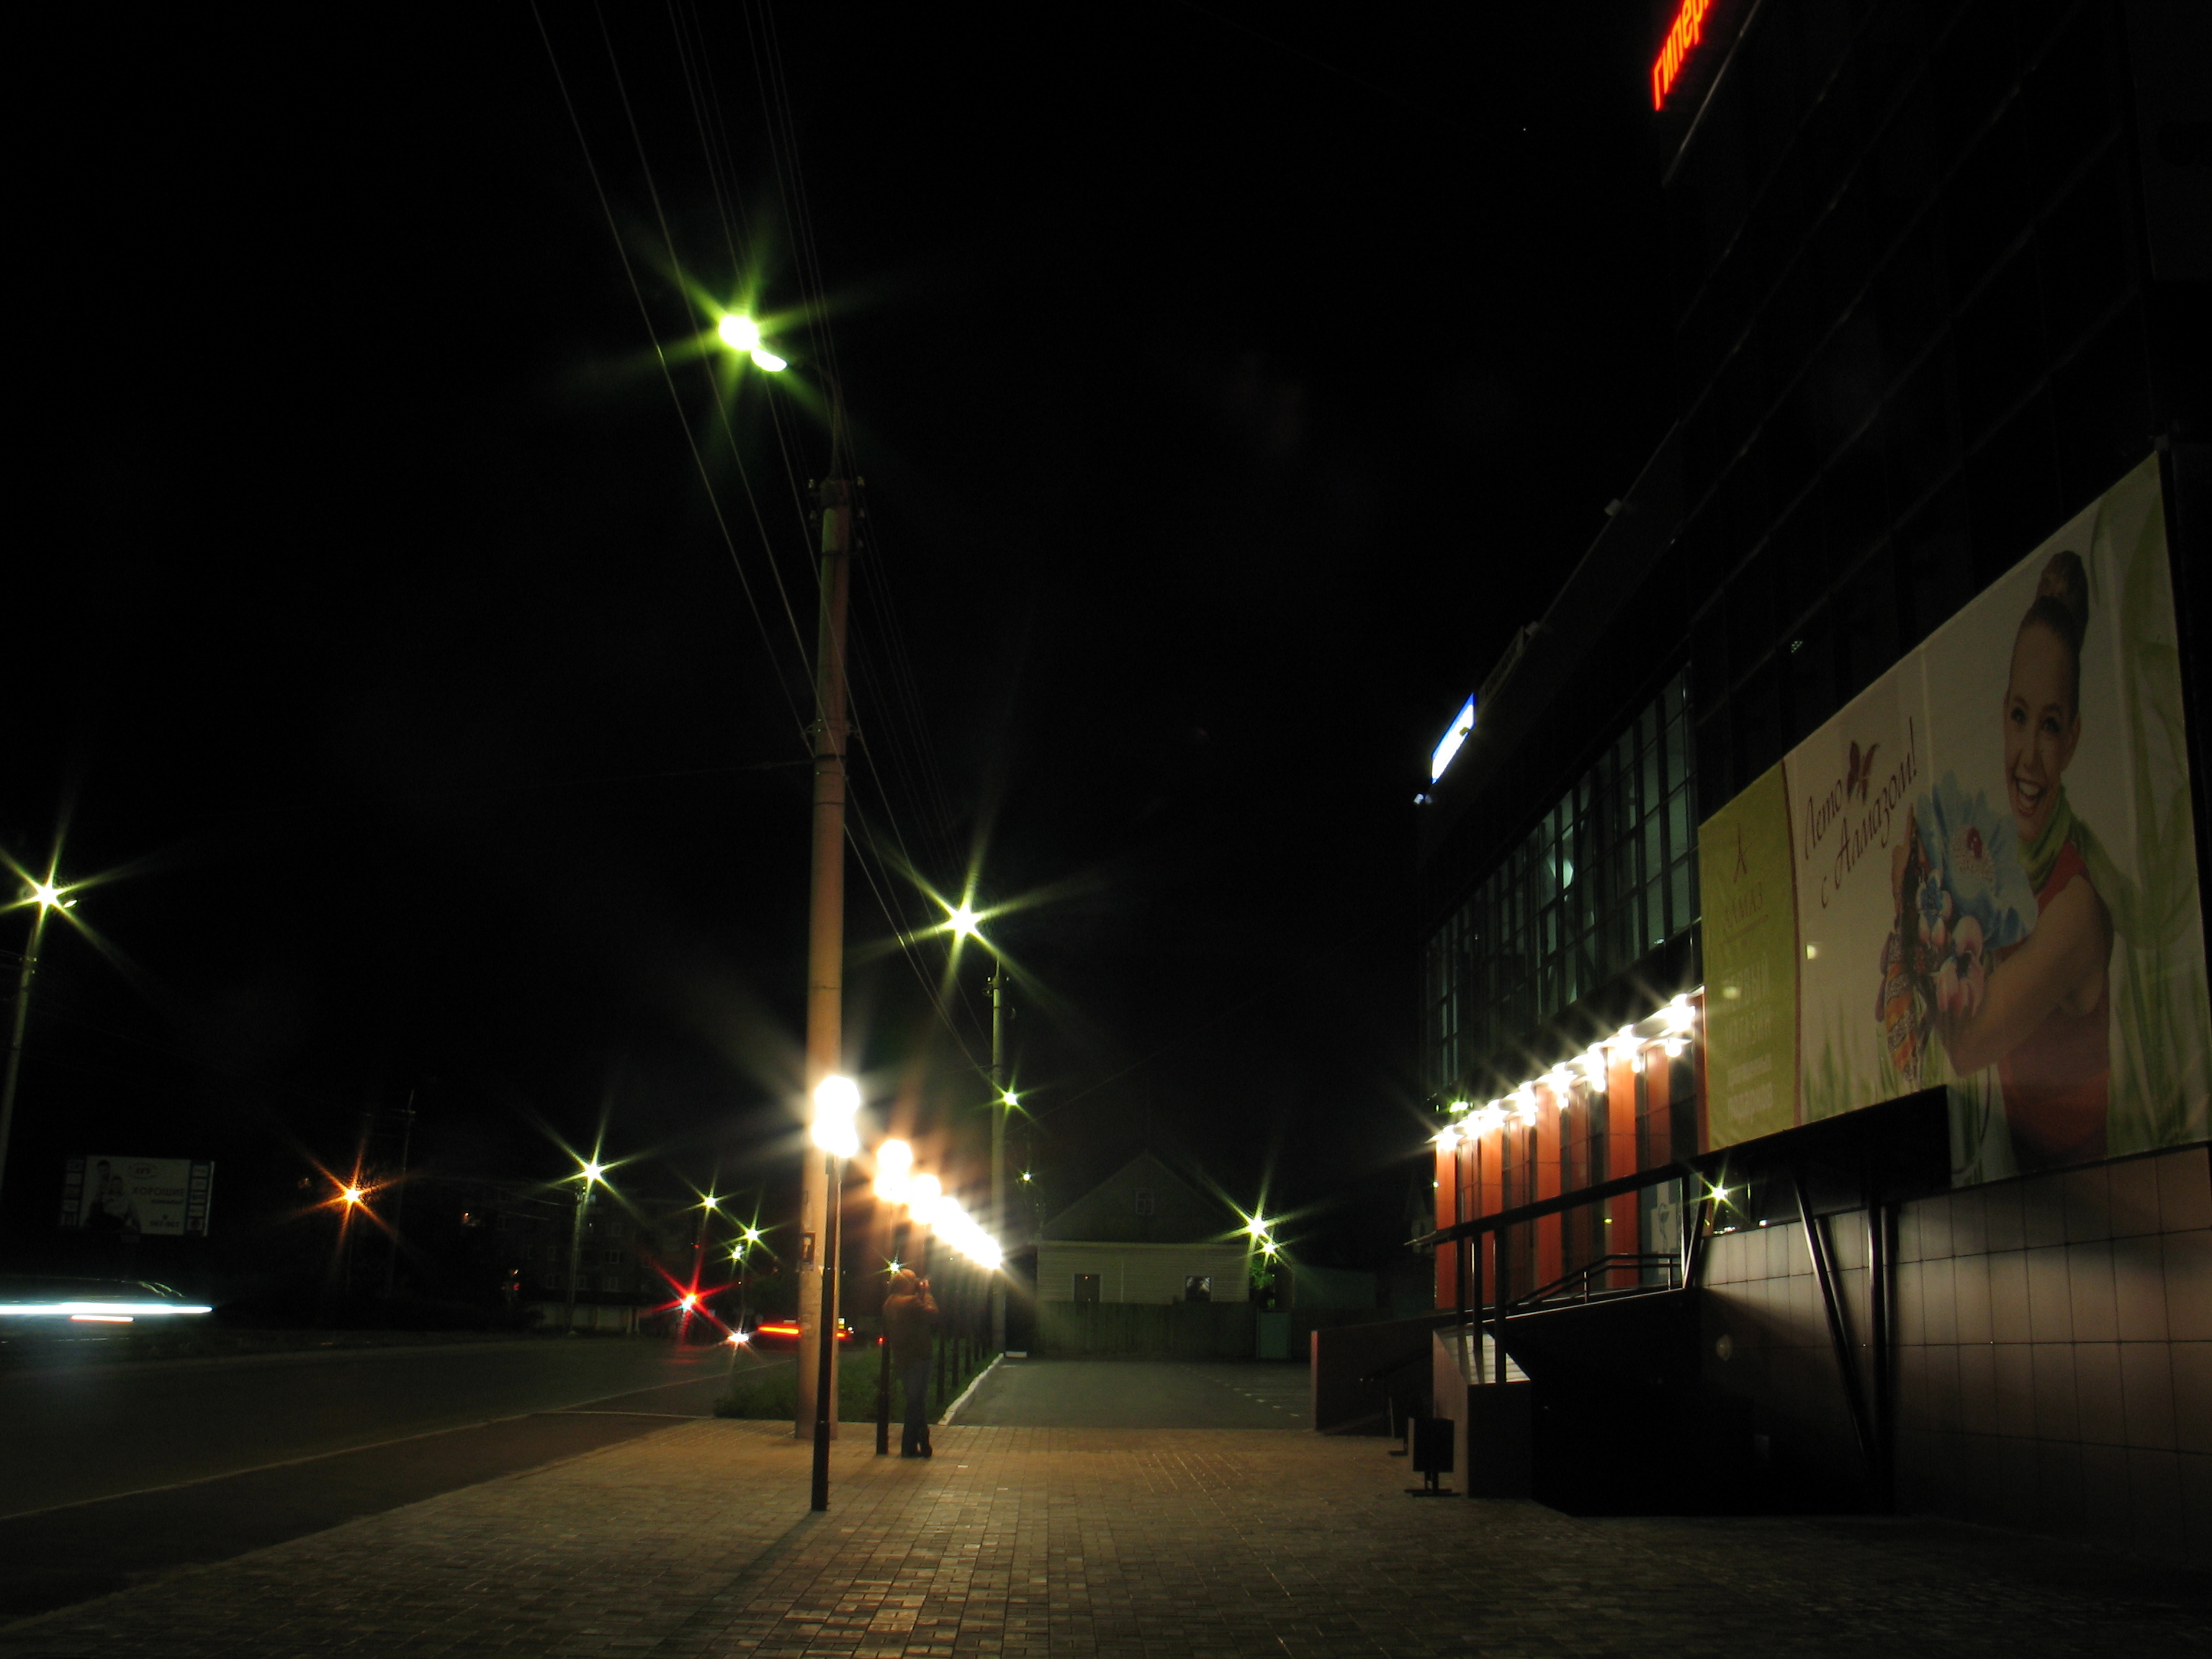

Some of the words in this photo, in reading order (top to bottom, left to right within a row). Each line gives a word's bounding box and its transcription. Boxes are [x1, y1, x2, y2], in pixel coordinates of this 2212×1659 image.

[1804, 778, 1843, 860] Лето
[1835, 716, 1917, 891] Алмазом!
[132, 1187, 185, 1197] ХОРОШИЕ
